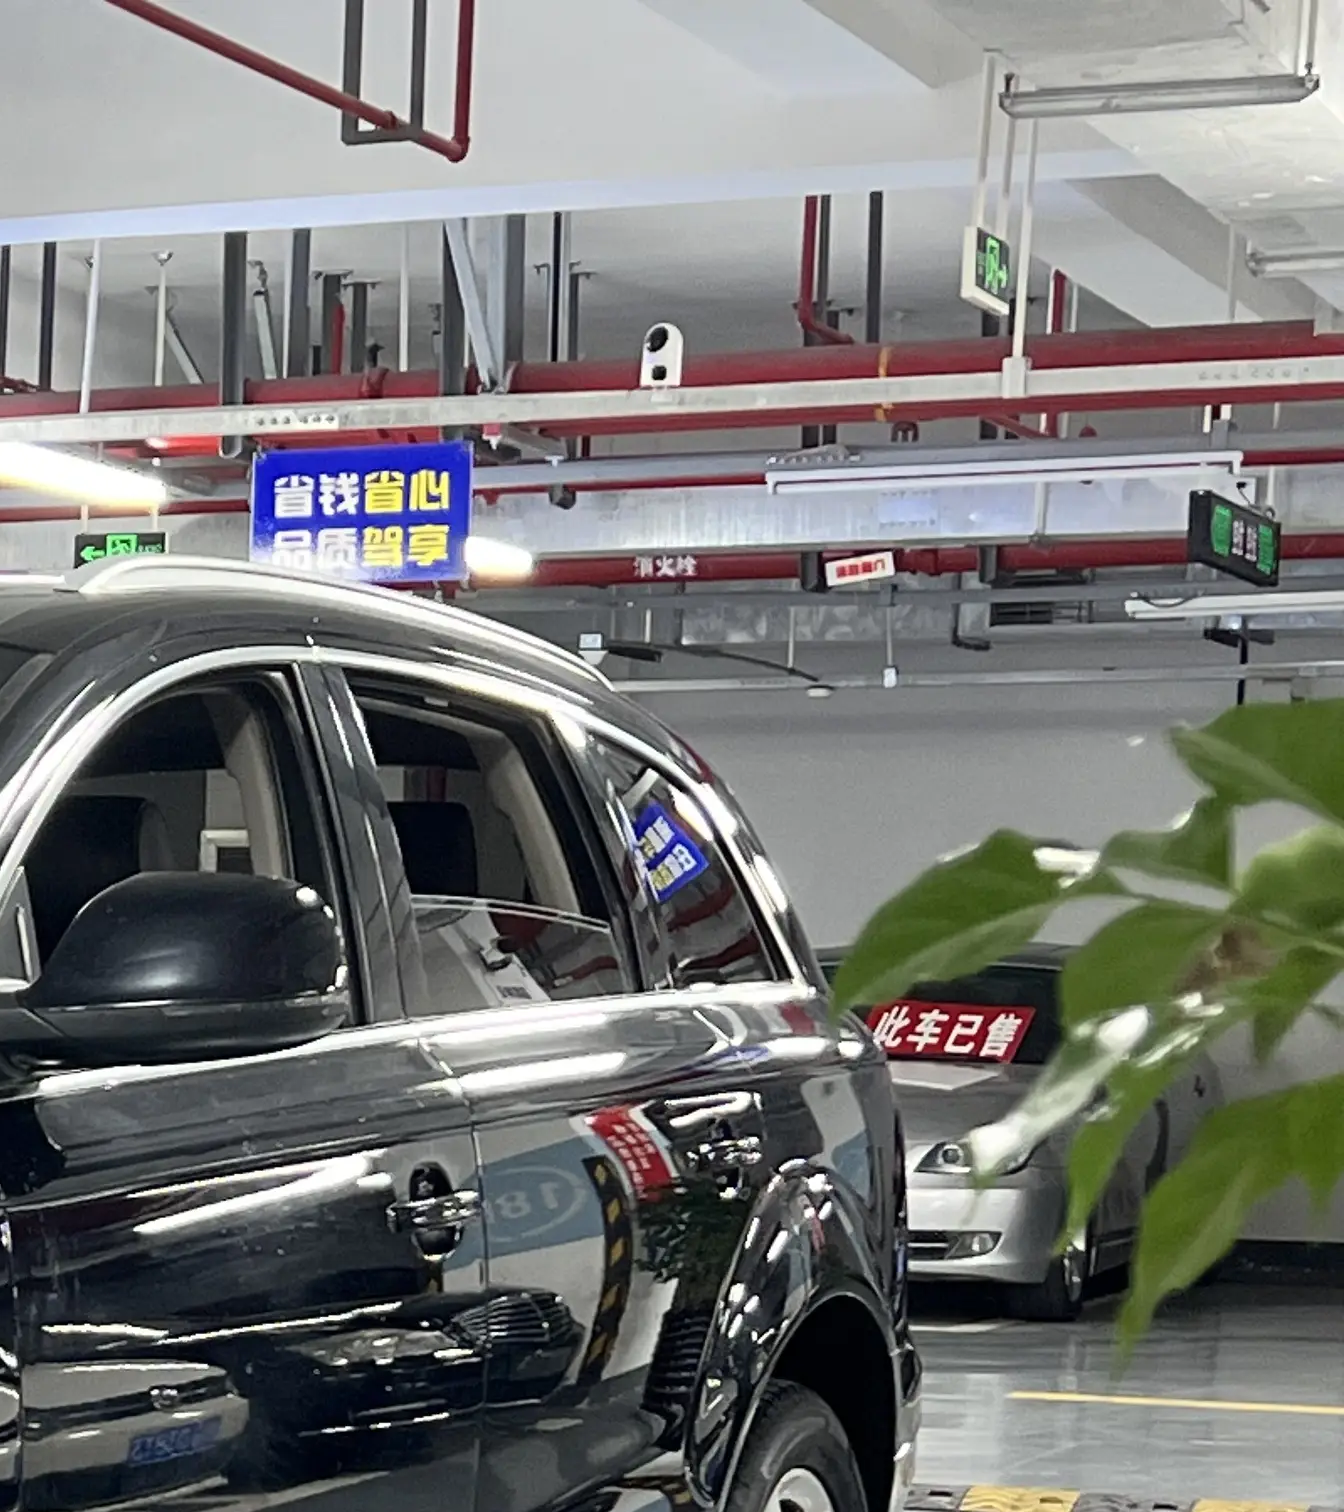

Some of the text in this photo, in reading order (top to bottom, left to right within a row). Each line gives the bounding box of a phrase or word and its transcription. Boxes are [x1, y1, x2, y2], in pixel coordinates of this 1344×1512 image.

[274, 469, 450, 518] 省钱省心
[271, 524, 449, 572] 品质驾享
[873, 1005, 1023, 1058] 此车已售
